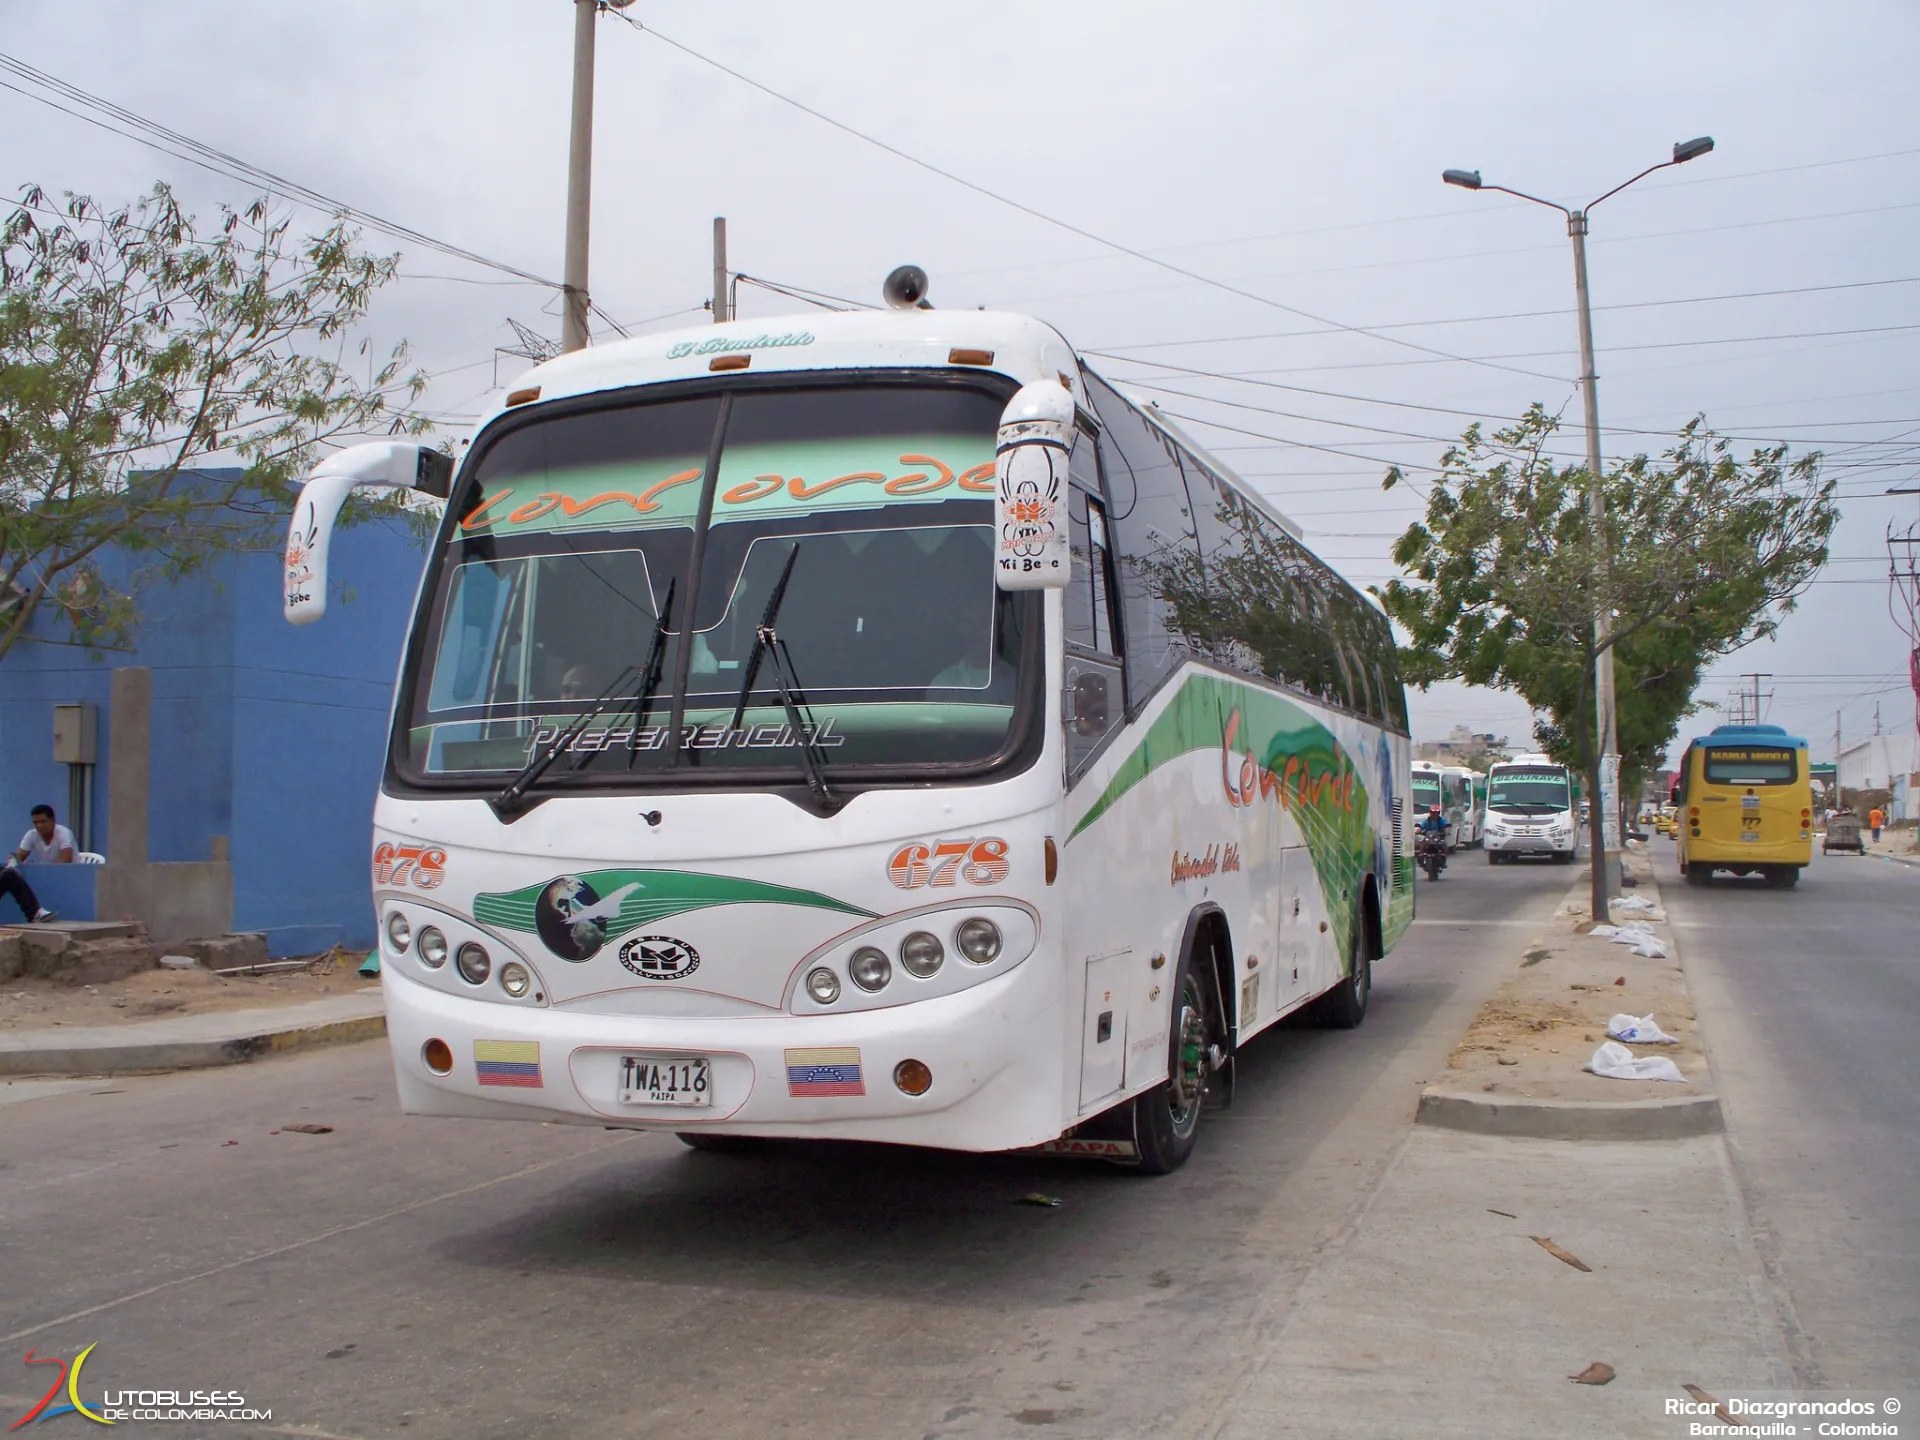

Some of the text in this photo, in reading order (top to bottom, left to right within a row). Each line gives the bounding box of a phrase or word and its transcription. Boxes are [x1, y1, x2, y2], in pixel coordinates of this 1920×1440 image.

[374, 841, 447, 890] 678
[886, 836, 1010, 891] 678
[651, 1091, 676, 1101] PAIPA
